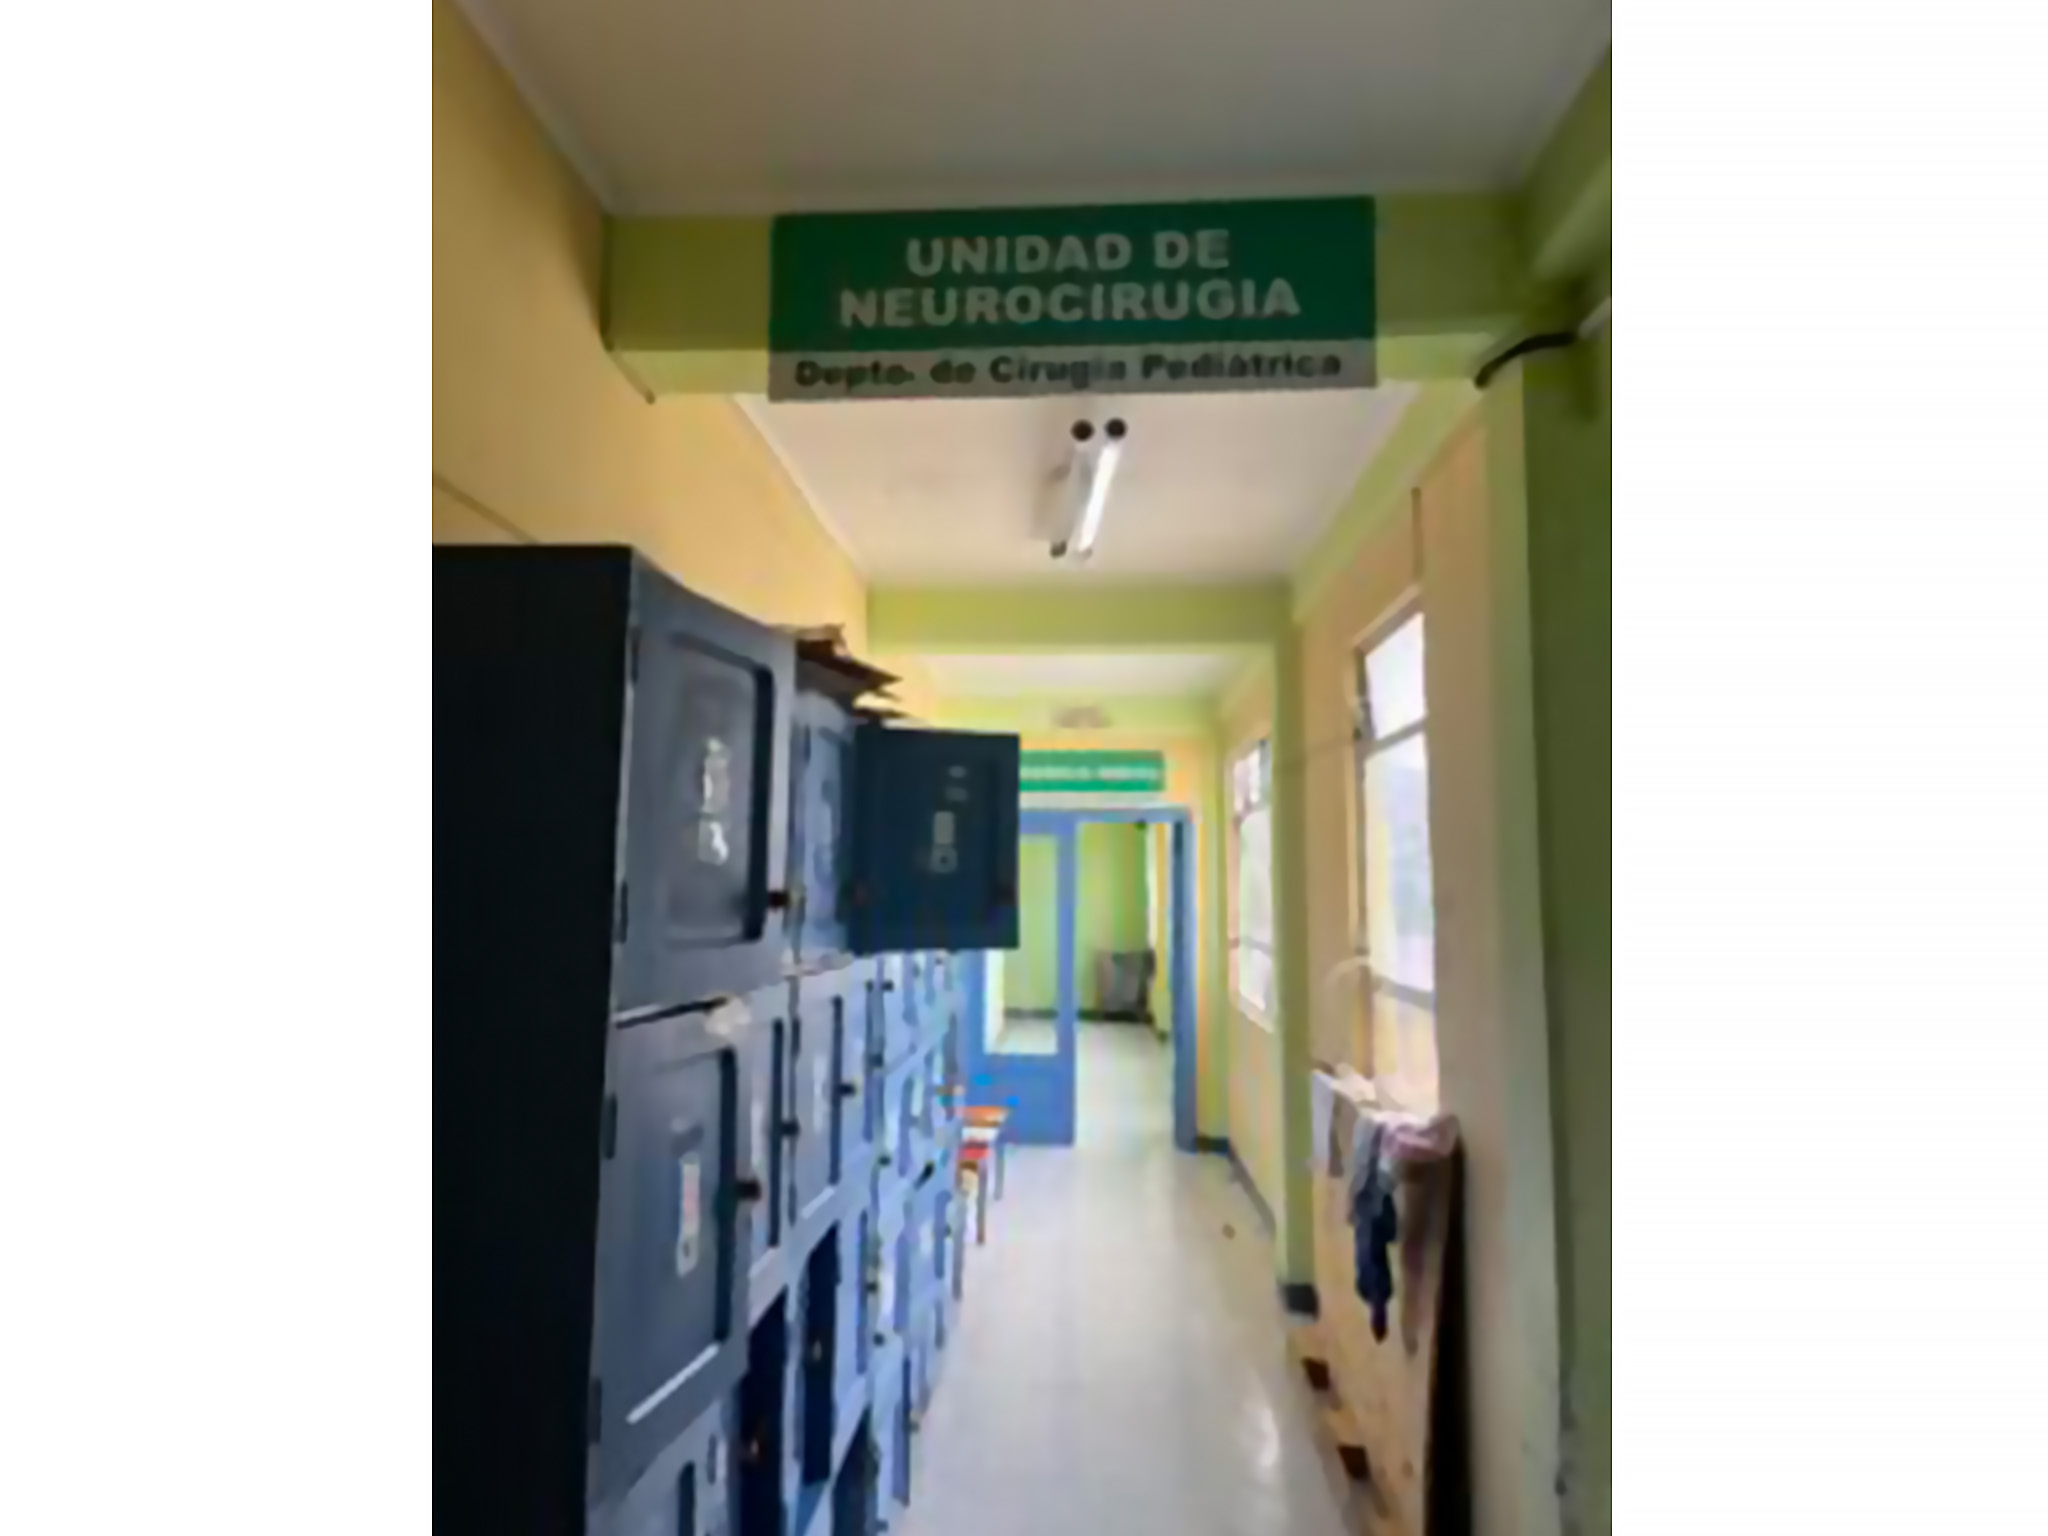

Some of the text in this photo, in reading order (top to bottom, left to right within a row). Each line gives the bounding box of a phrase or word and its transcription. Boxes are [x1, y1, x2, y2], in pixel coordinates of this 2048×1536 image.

[907, 229, 1230, 276] UNIDAD DE
[838, 279, 1301, 328] NEUROCIRUGIA
[929, 359, 976, 384] de
